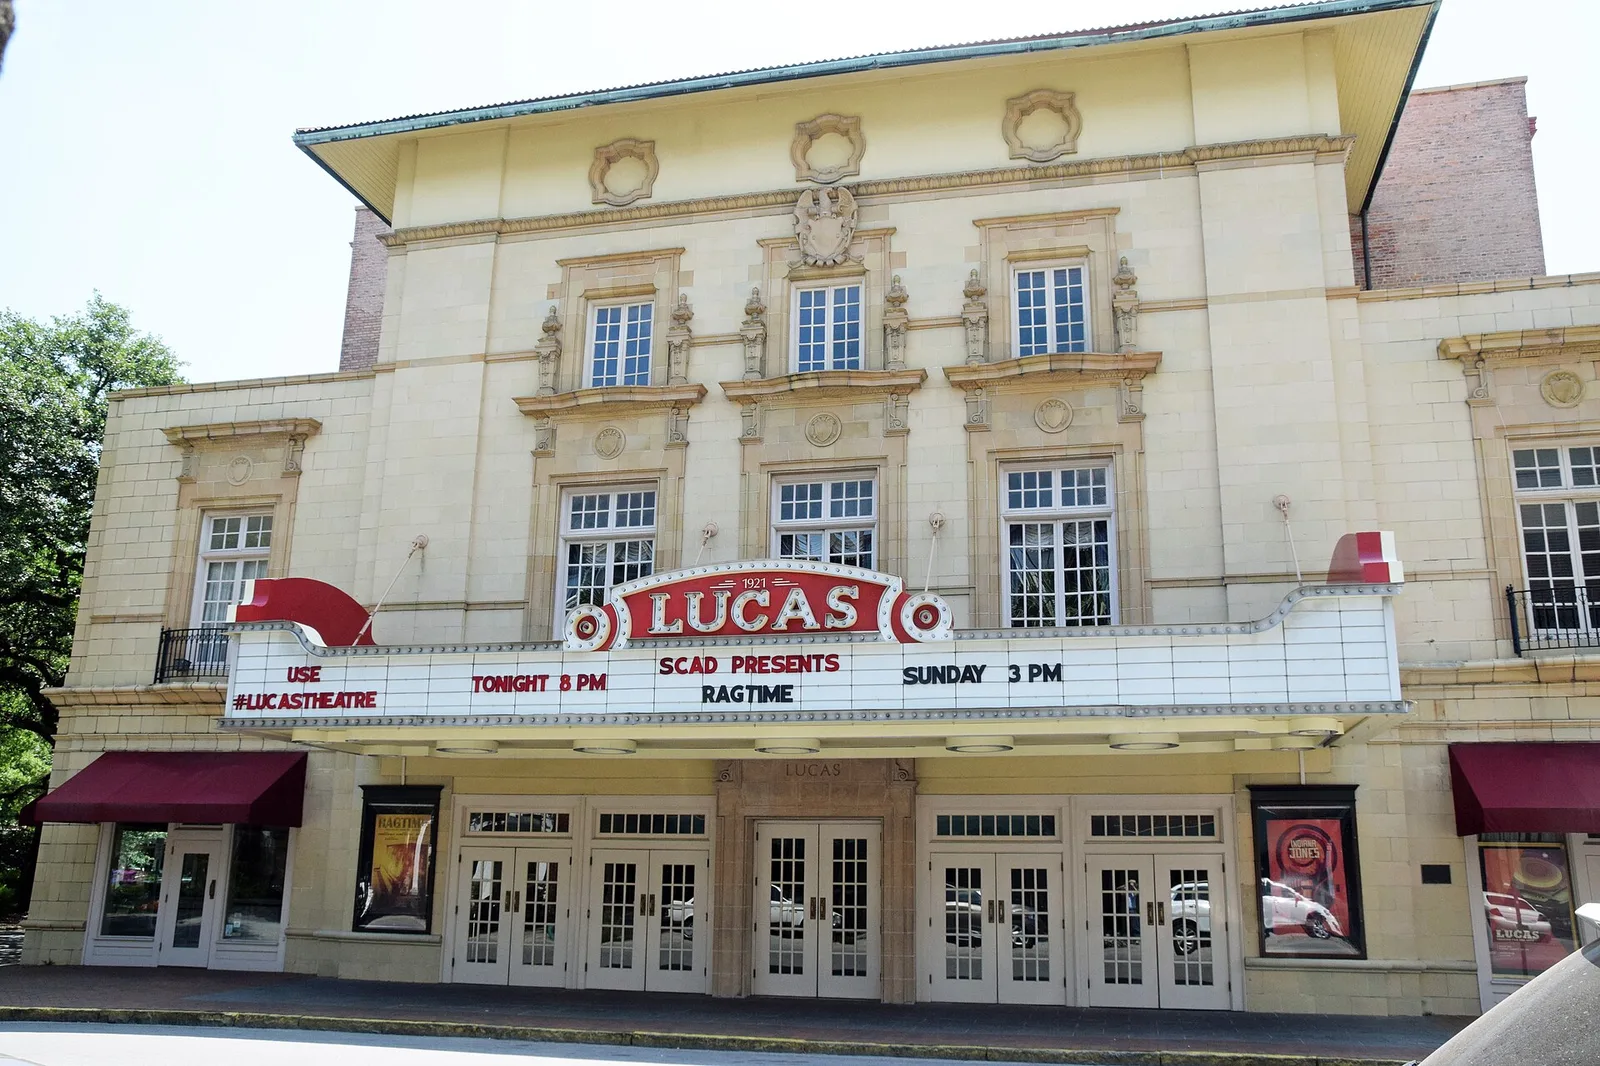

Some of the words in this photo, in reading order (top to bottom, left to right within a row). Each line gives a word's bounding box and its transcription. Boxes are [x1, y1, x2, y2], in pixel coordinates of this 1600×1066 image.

[741, 577, 766, 588] 1921
[648, 585, 859, 634] LUCAS
[660, 656, 718, 675] SCAD
[732, 654, 839, 674] PRESENTS
[287, 666, 321, 682] USE
[472, 675, 549, 692] TONIGHT
[559, 674, 571, 692] 8
[577, 673, 607, 691] PM
[903, 665, 986, 685] SUNDAY
[1008, 664, 1021, 683] 3
[1029, 663, 1063, 682] PM
[233, 691, 377, 710] #LUCASTHEATRE
[702, 685, 793, 704] RAGTIME
[785, 763, 841, 777] LUCAS
[1290, 839, 1317, 848] INDIANA
[1289, 847, 1320, 859] JONES
[1495, 929, 1540, 940] LUCAS
